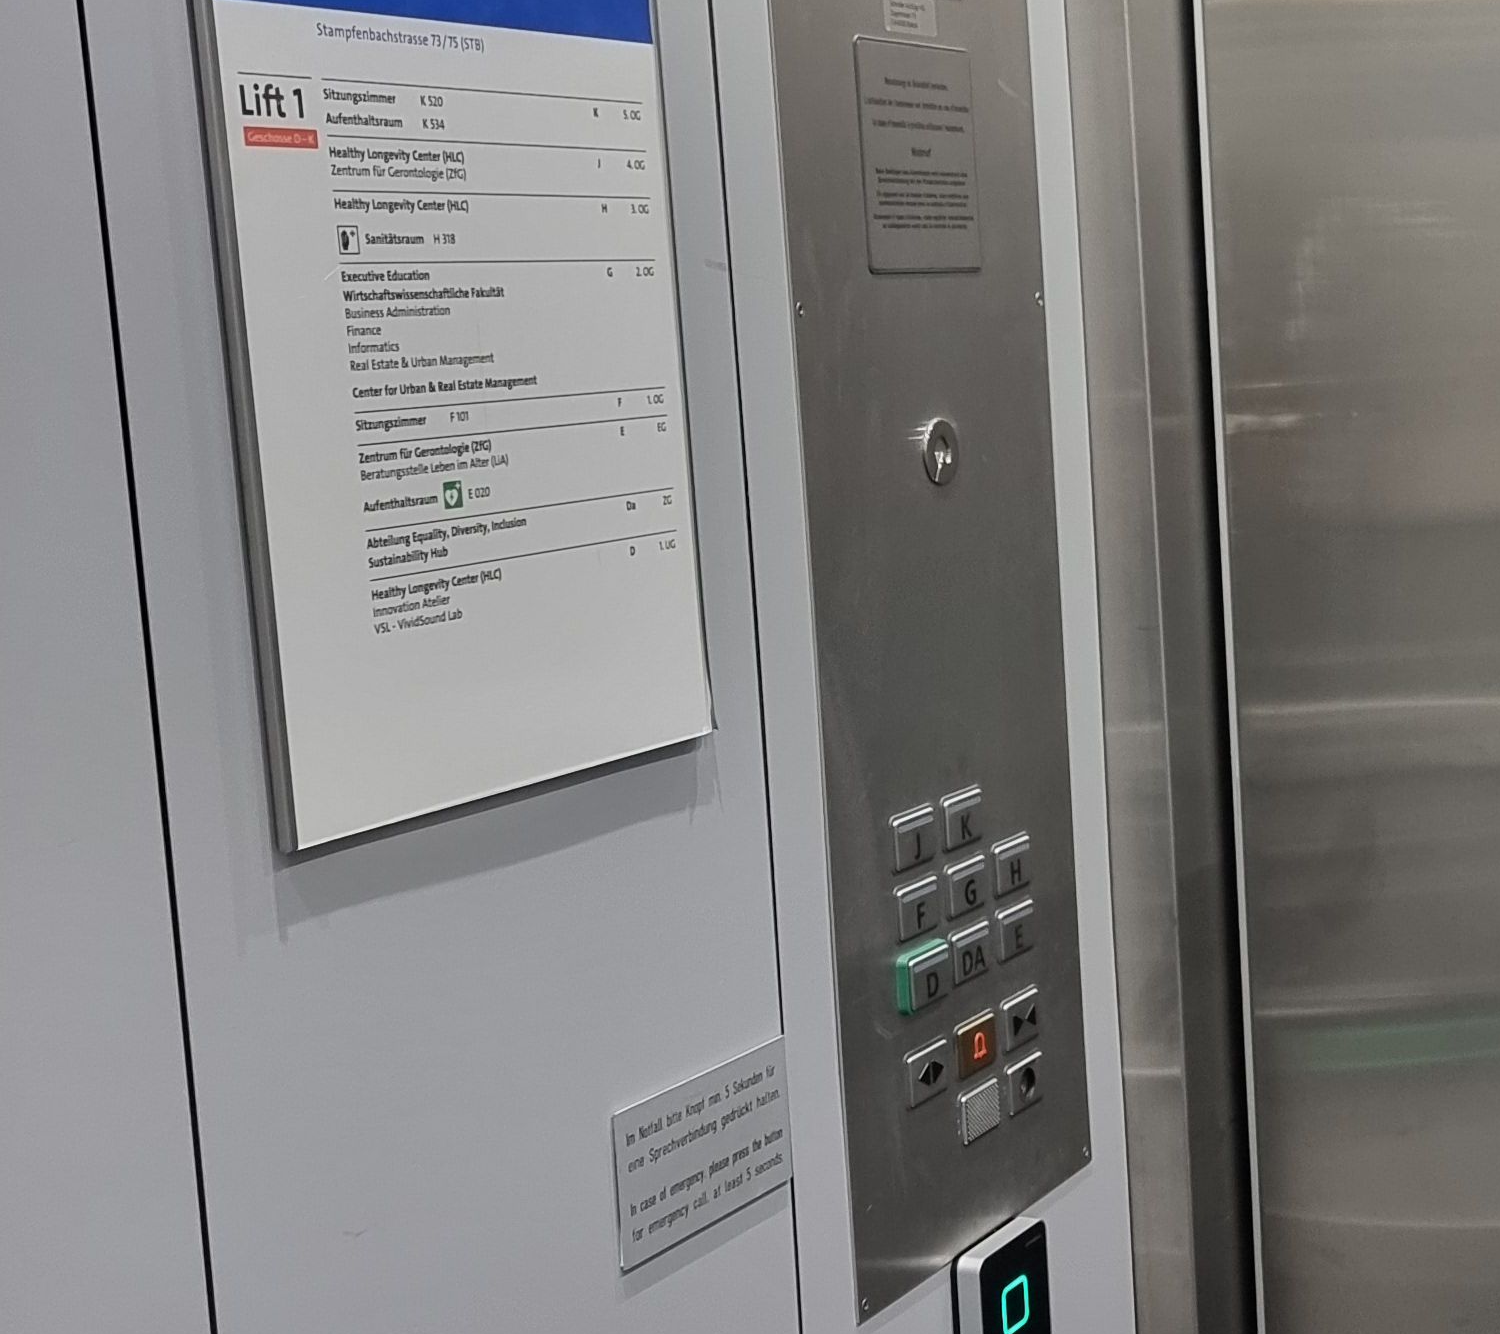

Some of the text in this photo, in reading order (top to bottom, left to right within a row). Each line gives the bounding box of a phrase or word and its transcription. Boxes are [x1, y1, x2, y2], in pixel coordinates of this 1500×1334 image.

[316, 22, 429, 47] Stampfenbachstrasse
[460, 36, 484, 53] (STB)
[238, 83, 305, 118] Lift 1
[323, 88, 443, 107] Sitzungszimmer K 520
[326, 113, 445, 130] Aufenthaltsraum K 534
[593, 107, 599, 117] K
[329, 147, 464, 165] Healthy Longevity Center (HLC)
[331, 164, 466, 182] Zentrum für Gerontologie (ZfG)
[334, 198, 469, 213] Healthy Longevity Center (HLC)
[601, 204, 608, 213] H
[365, 233, 456, 244] Sanitätsraum H 318
[341, 270, 430, 282] Executive Education
[607, 267, 613, 277] G
[343, 287, 505, 301] Wirtschaftswissenschaftliche Fakultät
[345, 305, 451, 319] Business Administration
[347, 325, 382, 336] Finance
[348, 341, 400, 354] Informatics
[350, 353, 494, 371] Real Estate & Urban Management
[352, 376, 537, 398] Center for Urban & Real Estate Management
[617, 397, 622, 407] F
[356, 411, 469, 432] Sitzungszimmer F 101
[620, 422, 667, 436] E EG
[359, 439, 492, 464] Zentrum für Gerontologie (ZfG)
[361, 464, 429, 480] Beratungsstelle
[431, 460, 456, 473] Leben
[457, 460, 468, 470] im
[470, 457, 489, 468] Alter
[363, 487, 490, 512] Aufenthaltsraum E 020
[626, 501, 636, 511] Da
[367, 517, 527, 549] Abteilung Equality, Diversity, Inclusion
[368, 547, 448, 568] Sustainability Hub
[630, 546, 635, 556] D
[372, 568, 502, 600] Healthy Longevity Center (HLC)
[373, 595, 451, 617] Innovation Atelier
[374, 622, 391, 634] VSL
[397, 612, 446, 630] VividSound
[448, 608, 463, 620] Lab
[961, 814, 973, 840] K
[915, 832, 921, 860] J
[1010, 858, 1021, 885] H
[965, 879, 977, 906] G
[916, 902, 925, 929] F
[1015, 924, 1023, 949] E
[963, 945, 986, 976] DA
[927, 972, 939, 998] D
[625, 1133, 635, 1147] Im
[638, 1118, 663, 1140] Notfall
[666, 1111, 682, 1127] bitte
[685, 1099, 705, 1116] Knopf
[725, 1084, 730, 1099] 5
[733, 1071, 763, 1095] Sekunden
[628, 1156, 644, 1172] eine
[649, 1119, 717, 1164] Sprechverbindung
[721, 1101, 753, 1130] gedrückt
[630, 1203, 637, 1217] In
[640, 1194, 657, 1212] case
[660, 1186, 666, 1202] of
[709, 1156, 730, 1177] please
[732, 1146, 750, 1165] press
[752, 1138, 762, 1153] the
[764, 1129, 783, 1146] button
[632, 1228, 643, 1243] for
[648, 1205, 689, 1234] emergency
[713, 1185, 721, 1199] at
[725, 1173, 743, 1192] least
[746, 1167, 751, 1181] 5
